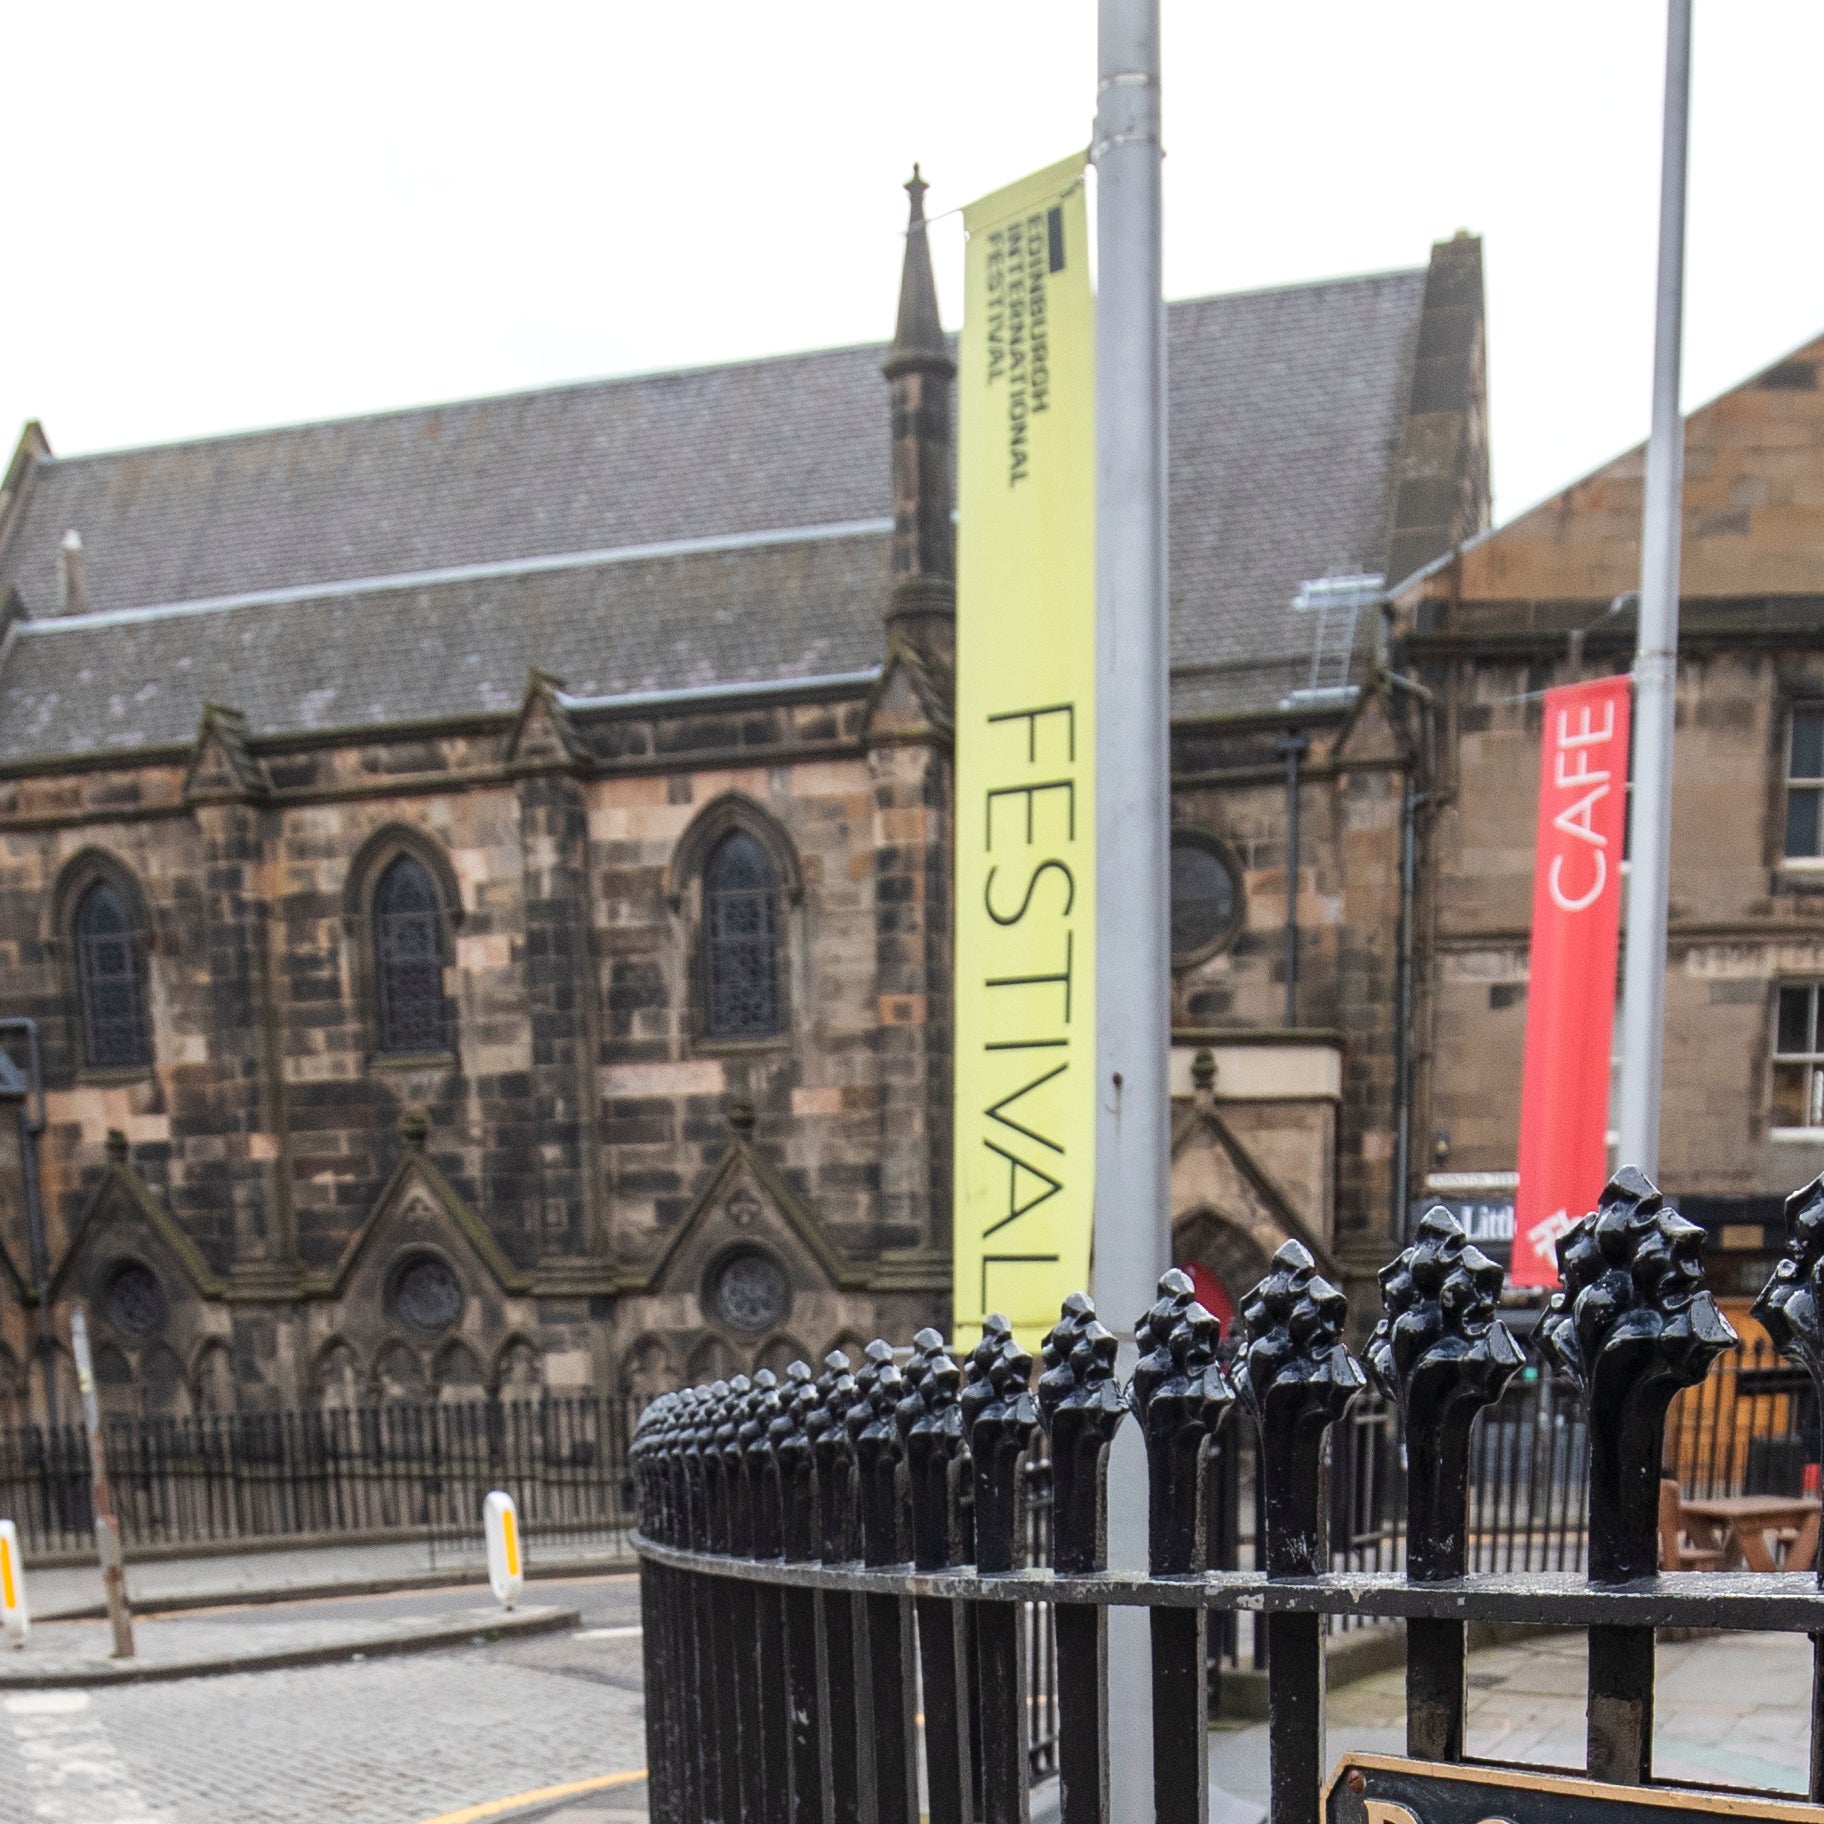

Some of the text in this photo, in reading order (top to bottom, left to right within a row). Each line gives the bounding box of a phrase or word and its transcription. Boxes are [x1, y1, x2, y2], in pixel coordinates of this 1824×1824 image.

[985, 229, 1005, 386] FESTIVAL
[1007, 221, 1030, 489] INTERNATIONAL
[1026, 212, 1050, 414] EDINBURGH
[1548, 699, 1615, 912] CAFE
[981, 700, 1076, 1315] FESTIVAL
[1460, 1204, 1516, 1241] Littl
